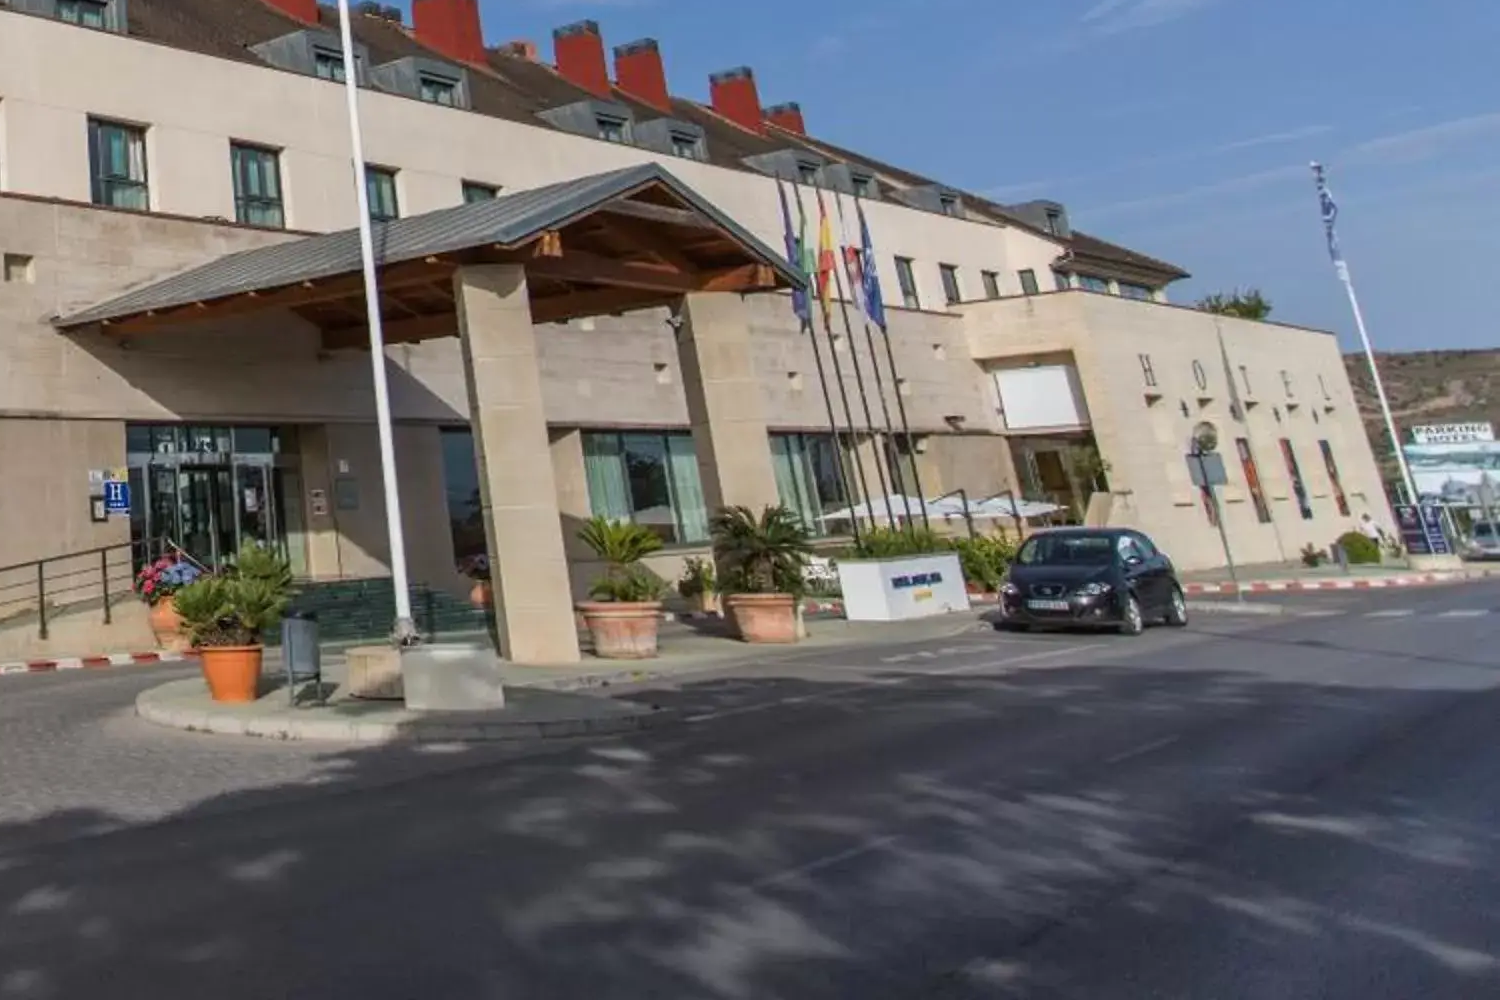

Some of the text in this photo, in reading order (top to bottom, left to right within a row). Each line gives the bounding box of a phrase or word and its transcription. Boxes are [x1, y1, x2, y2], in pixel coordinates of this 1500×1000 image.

[1138, 353, 1331, 401] HOTEL
[1414, 424, 1490, 435] PARKING
[1426, 433, 1479, 442] HOTEL
[110, 483, 123, 501] H
